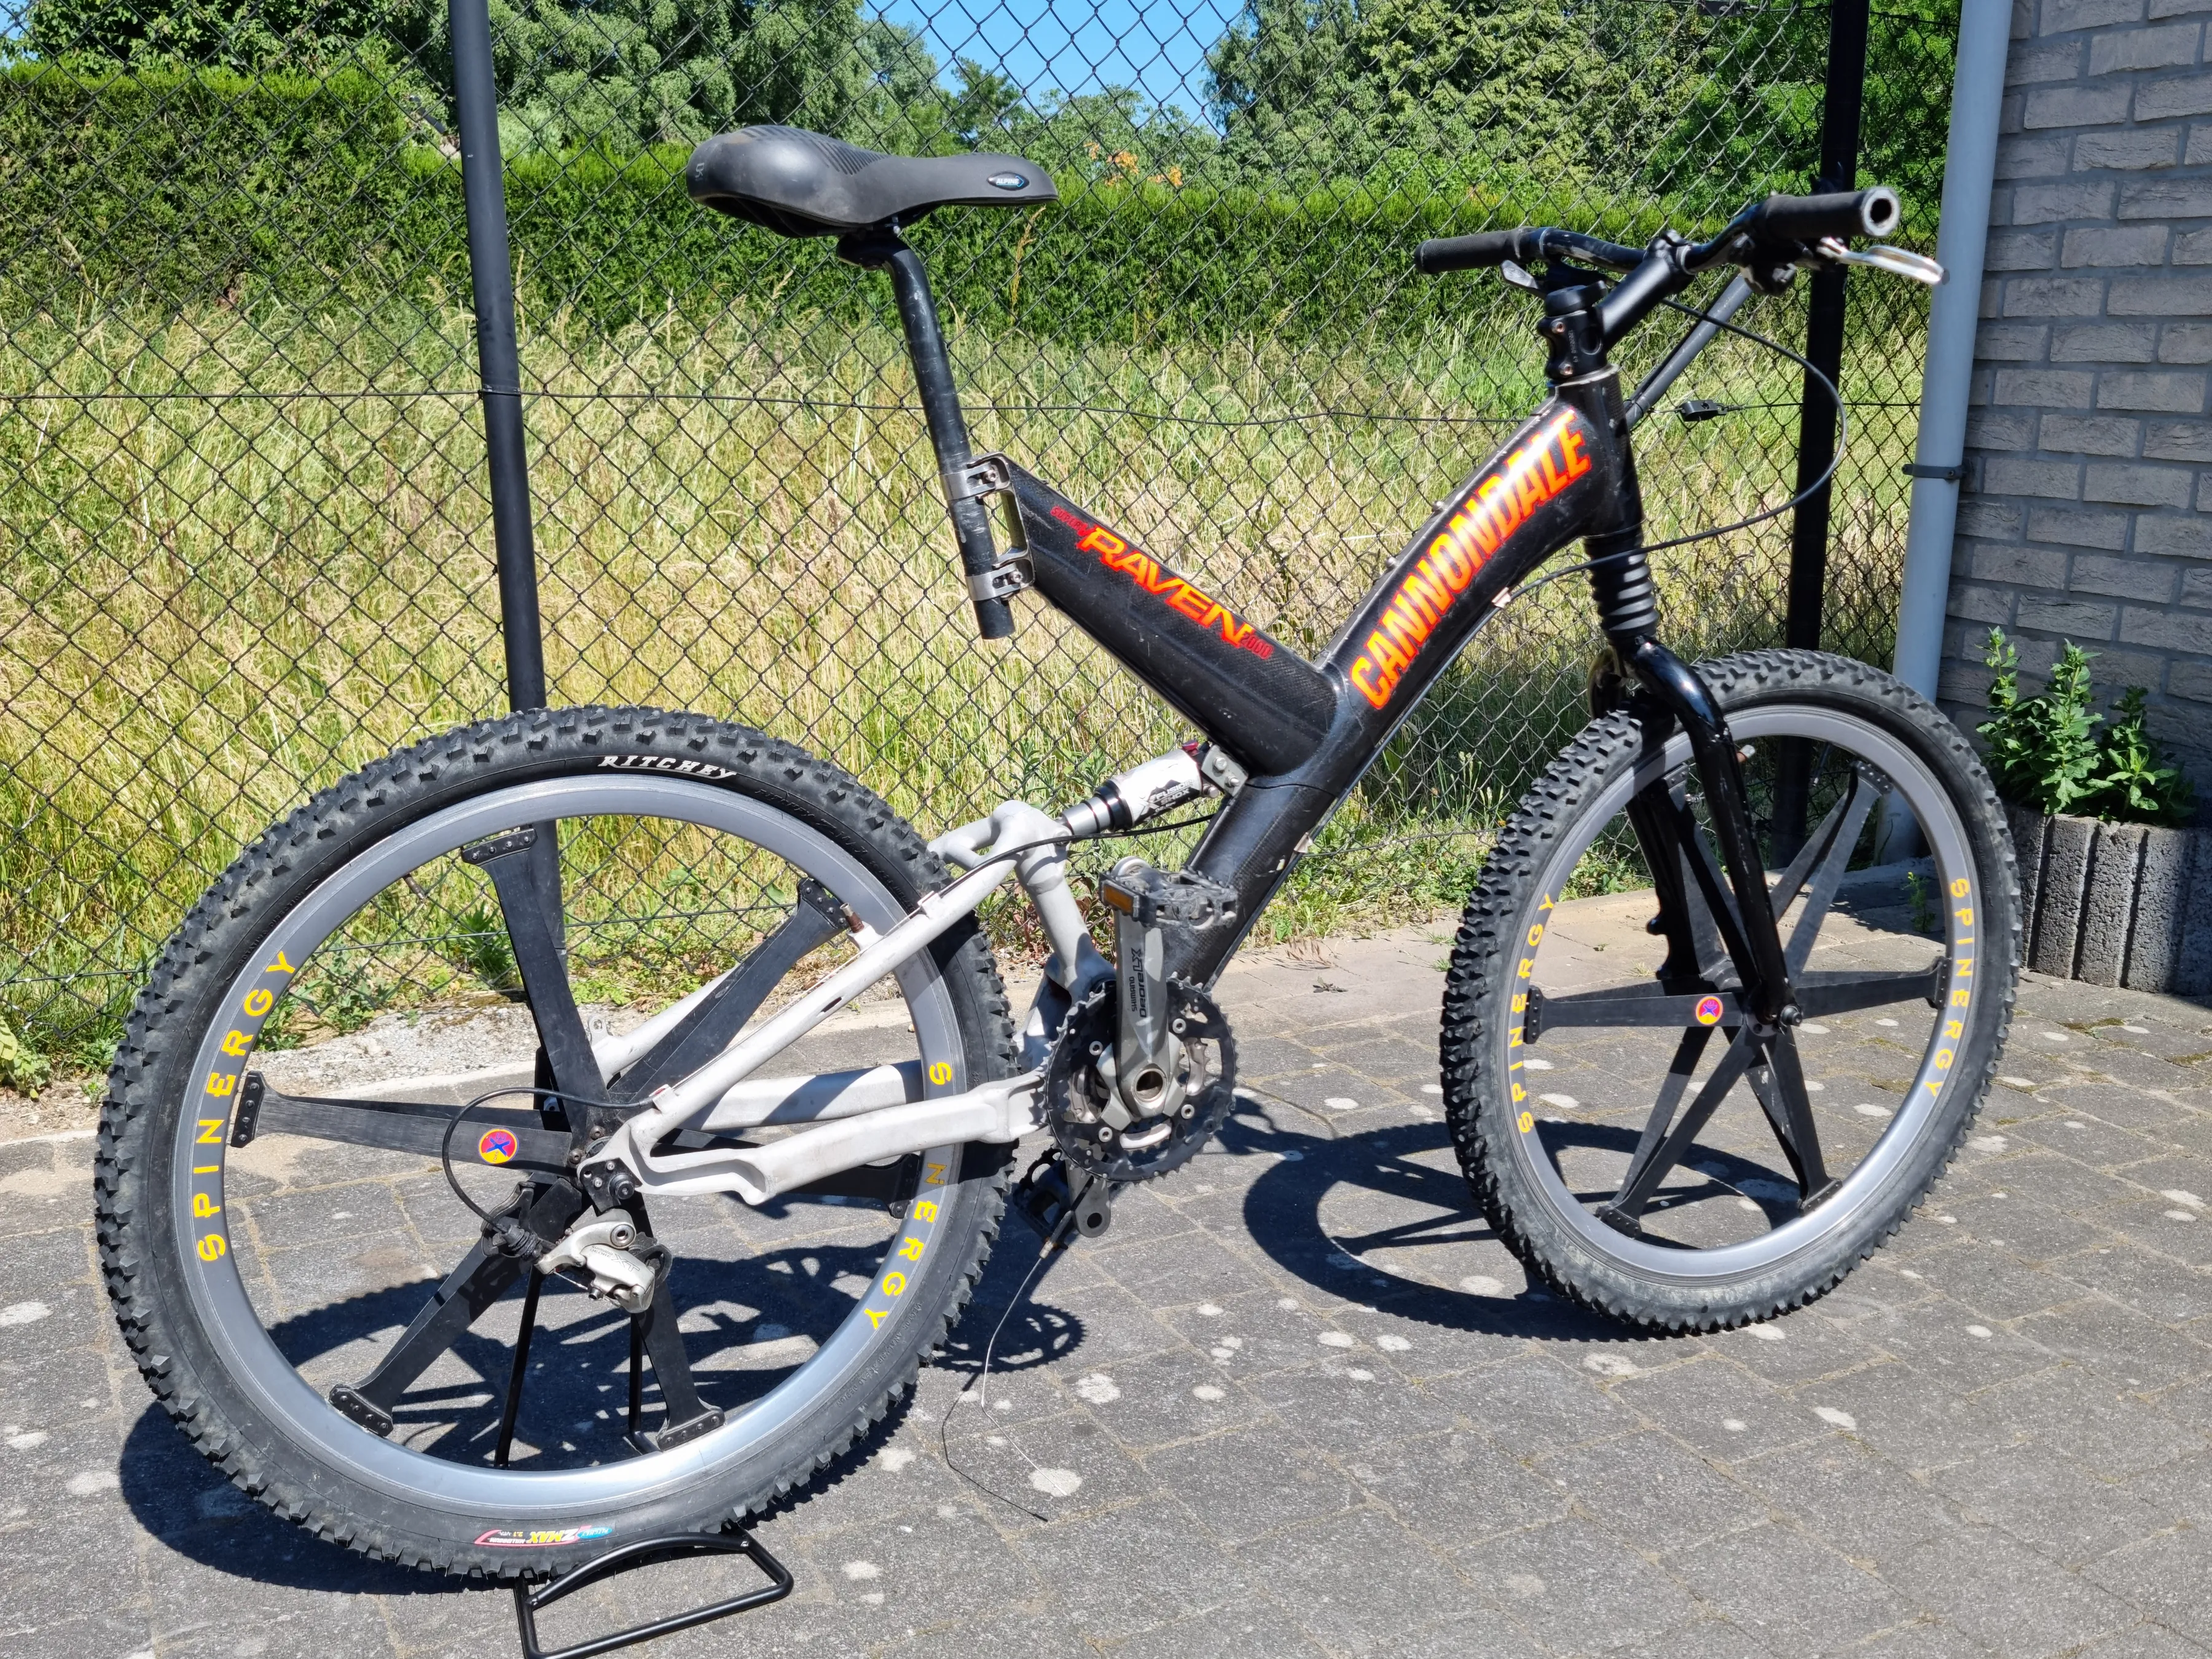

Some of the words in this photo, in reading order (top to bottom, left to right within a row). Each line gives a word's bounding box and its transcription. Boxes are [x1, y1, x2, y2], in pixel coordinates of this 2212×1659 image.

[1076, 524, 1255, 648] RAVEN
[1350, 407, 1591, 710] CANNONDALE
[1240, 632, 1274, 660] 2000
[597, 755, 737, 779] RITCHEY
[1161, 788, 1190, 806] SHOX
[1129, 976, 1137, 1012] SHIMANO
[1509, 893, 1554, 1134] SPINERGY
[1924, 878, 1974, 1097] SPINERGY
[192, 950, 296, 1261] SPINERGY
[864, 1062, 952, 1330] SNERGY
[903, 1303, 922, 1331] VECTOR
[527, 1528, 579, 1544] ZMAX
